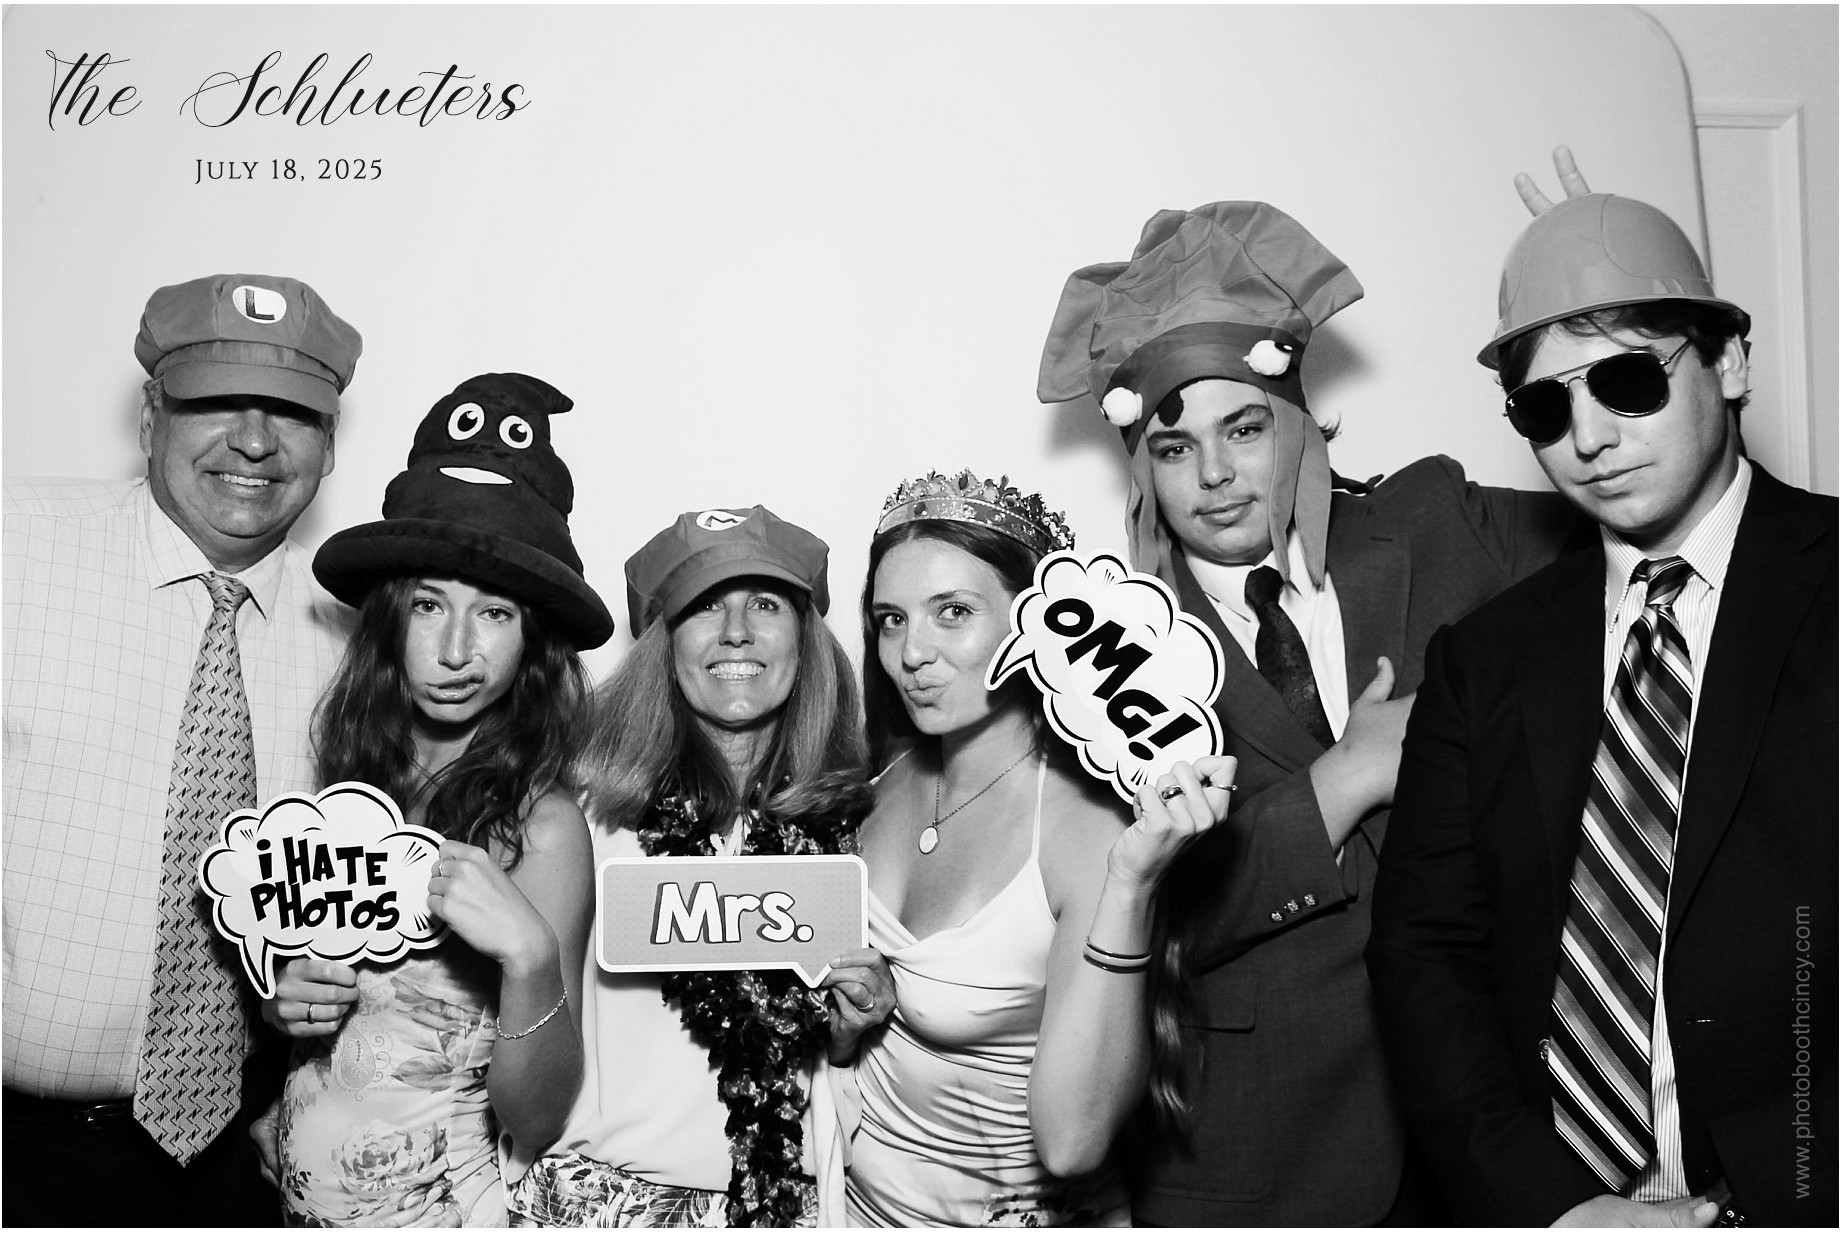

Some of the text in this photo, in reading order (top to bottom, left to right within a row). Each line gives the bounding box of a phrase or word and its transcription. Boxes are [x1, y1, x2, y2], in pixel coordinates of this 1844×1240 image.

[245, 288, 275, 320] L
[704, 515, 738, 528] M
[1044, 598, 1203, 761] OMG!
[282, 836, 389, 886] HATE
[650, 881, 814, 944] Mrs.
